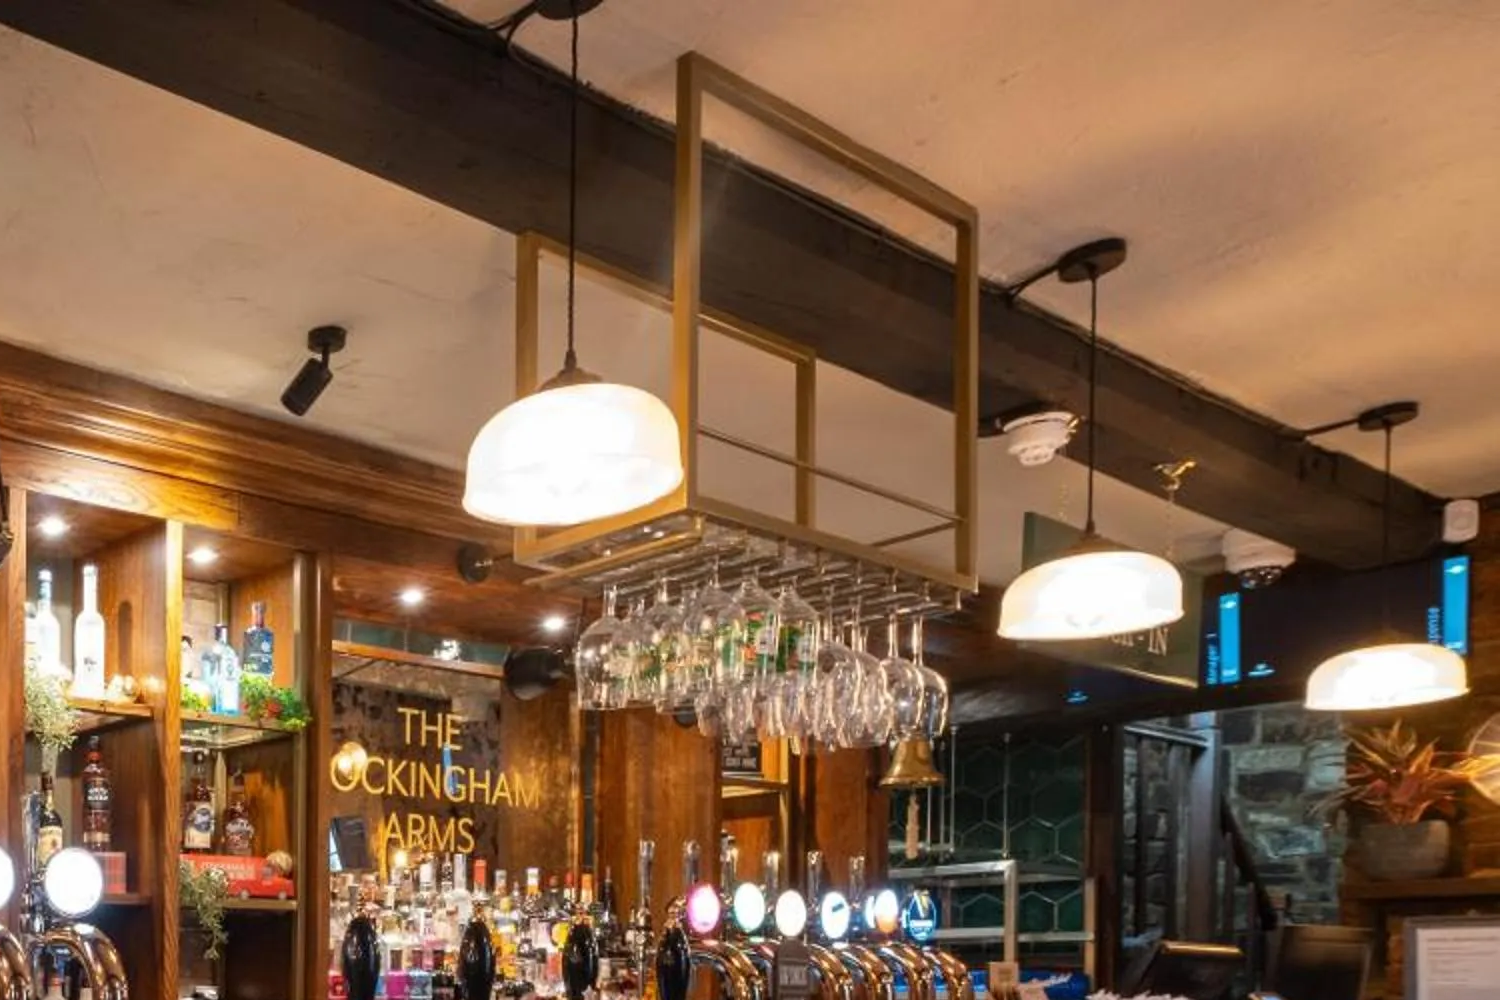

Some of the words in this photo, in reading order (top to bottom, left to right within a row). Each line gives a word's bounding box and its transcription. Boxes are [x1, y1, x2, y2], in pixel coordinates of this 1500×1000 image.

[396, 707, 464, 751] THE
[330, 751, 540, 809] OCKINGHAM
[384, 812, 476, 854] ARMS
